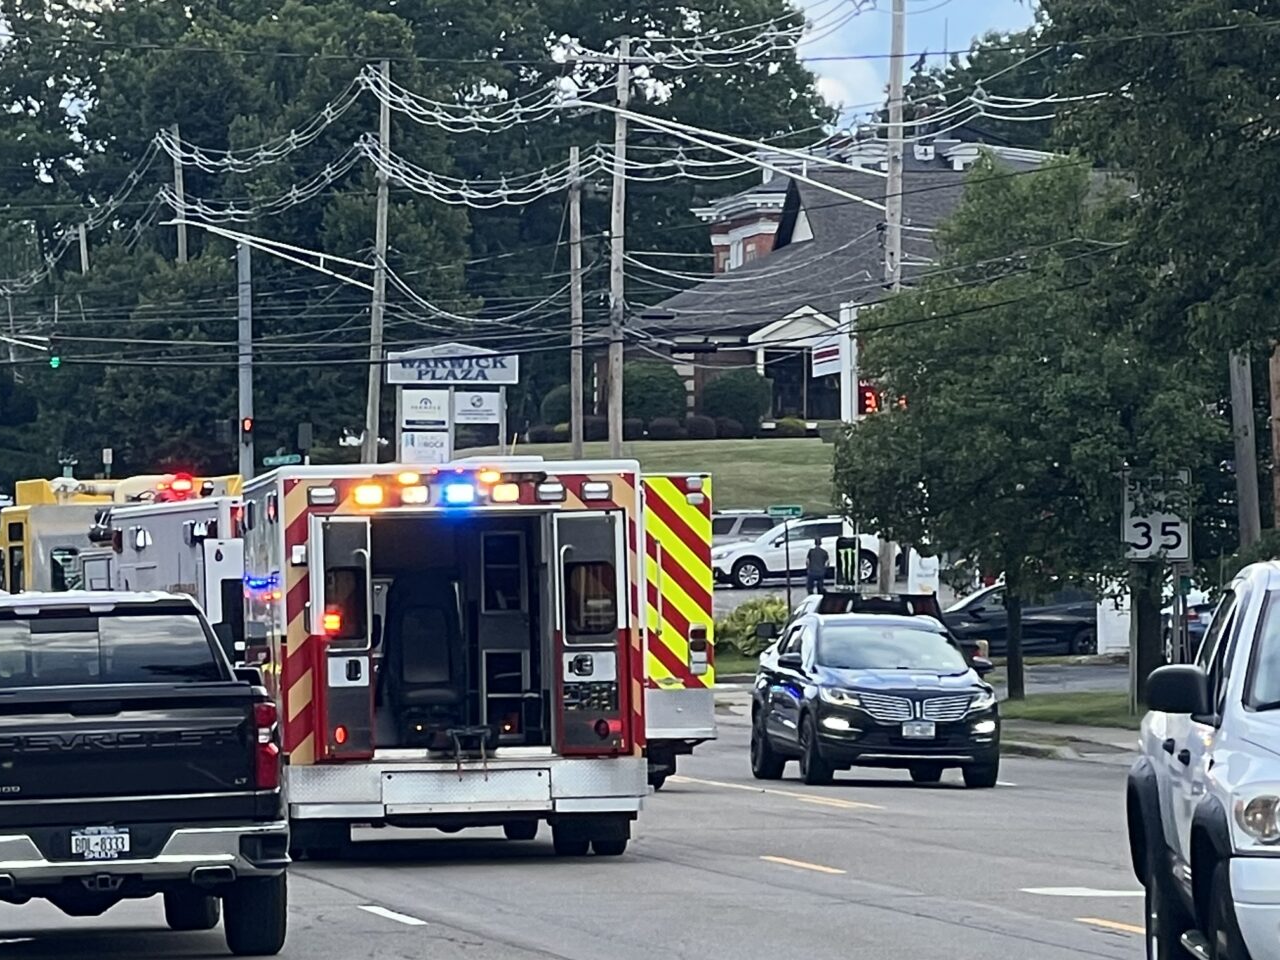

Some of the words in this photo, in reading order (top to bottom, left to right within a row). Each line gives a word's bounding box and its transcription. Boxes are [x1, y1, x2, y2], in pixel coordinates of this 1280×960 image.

[400, 356, 507, 369] WARWICK
[417, 369, 489, 381] PLAZA
[1131, 522, 1182, 550] 35
